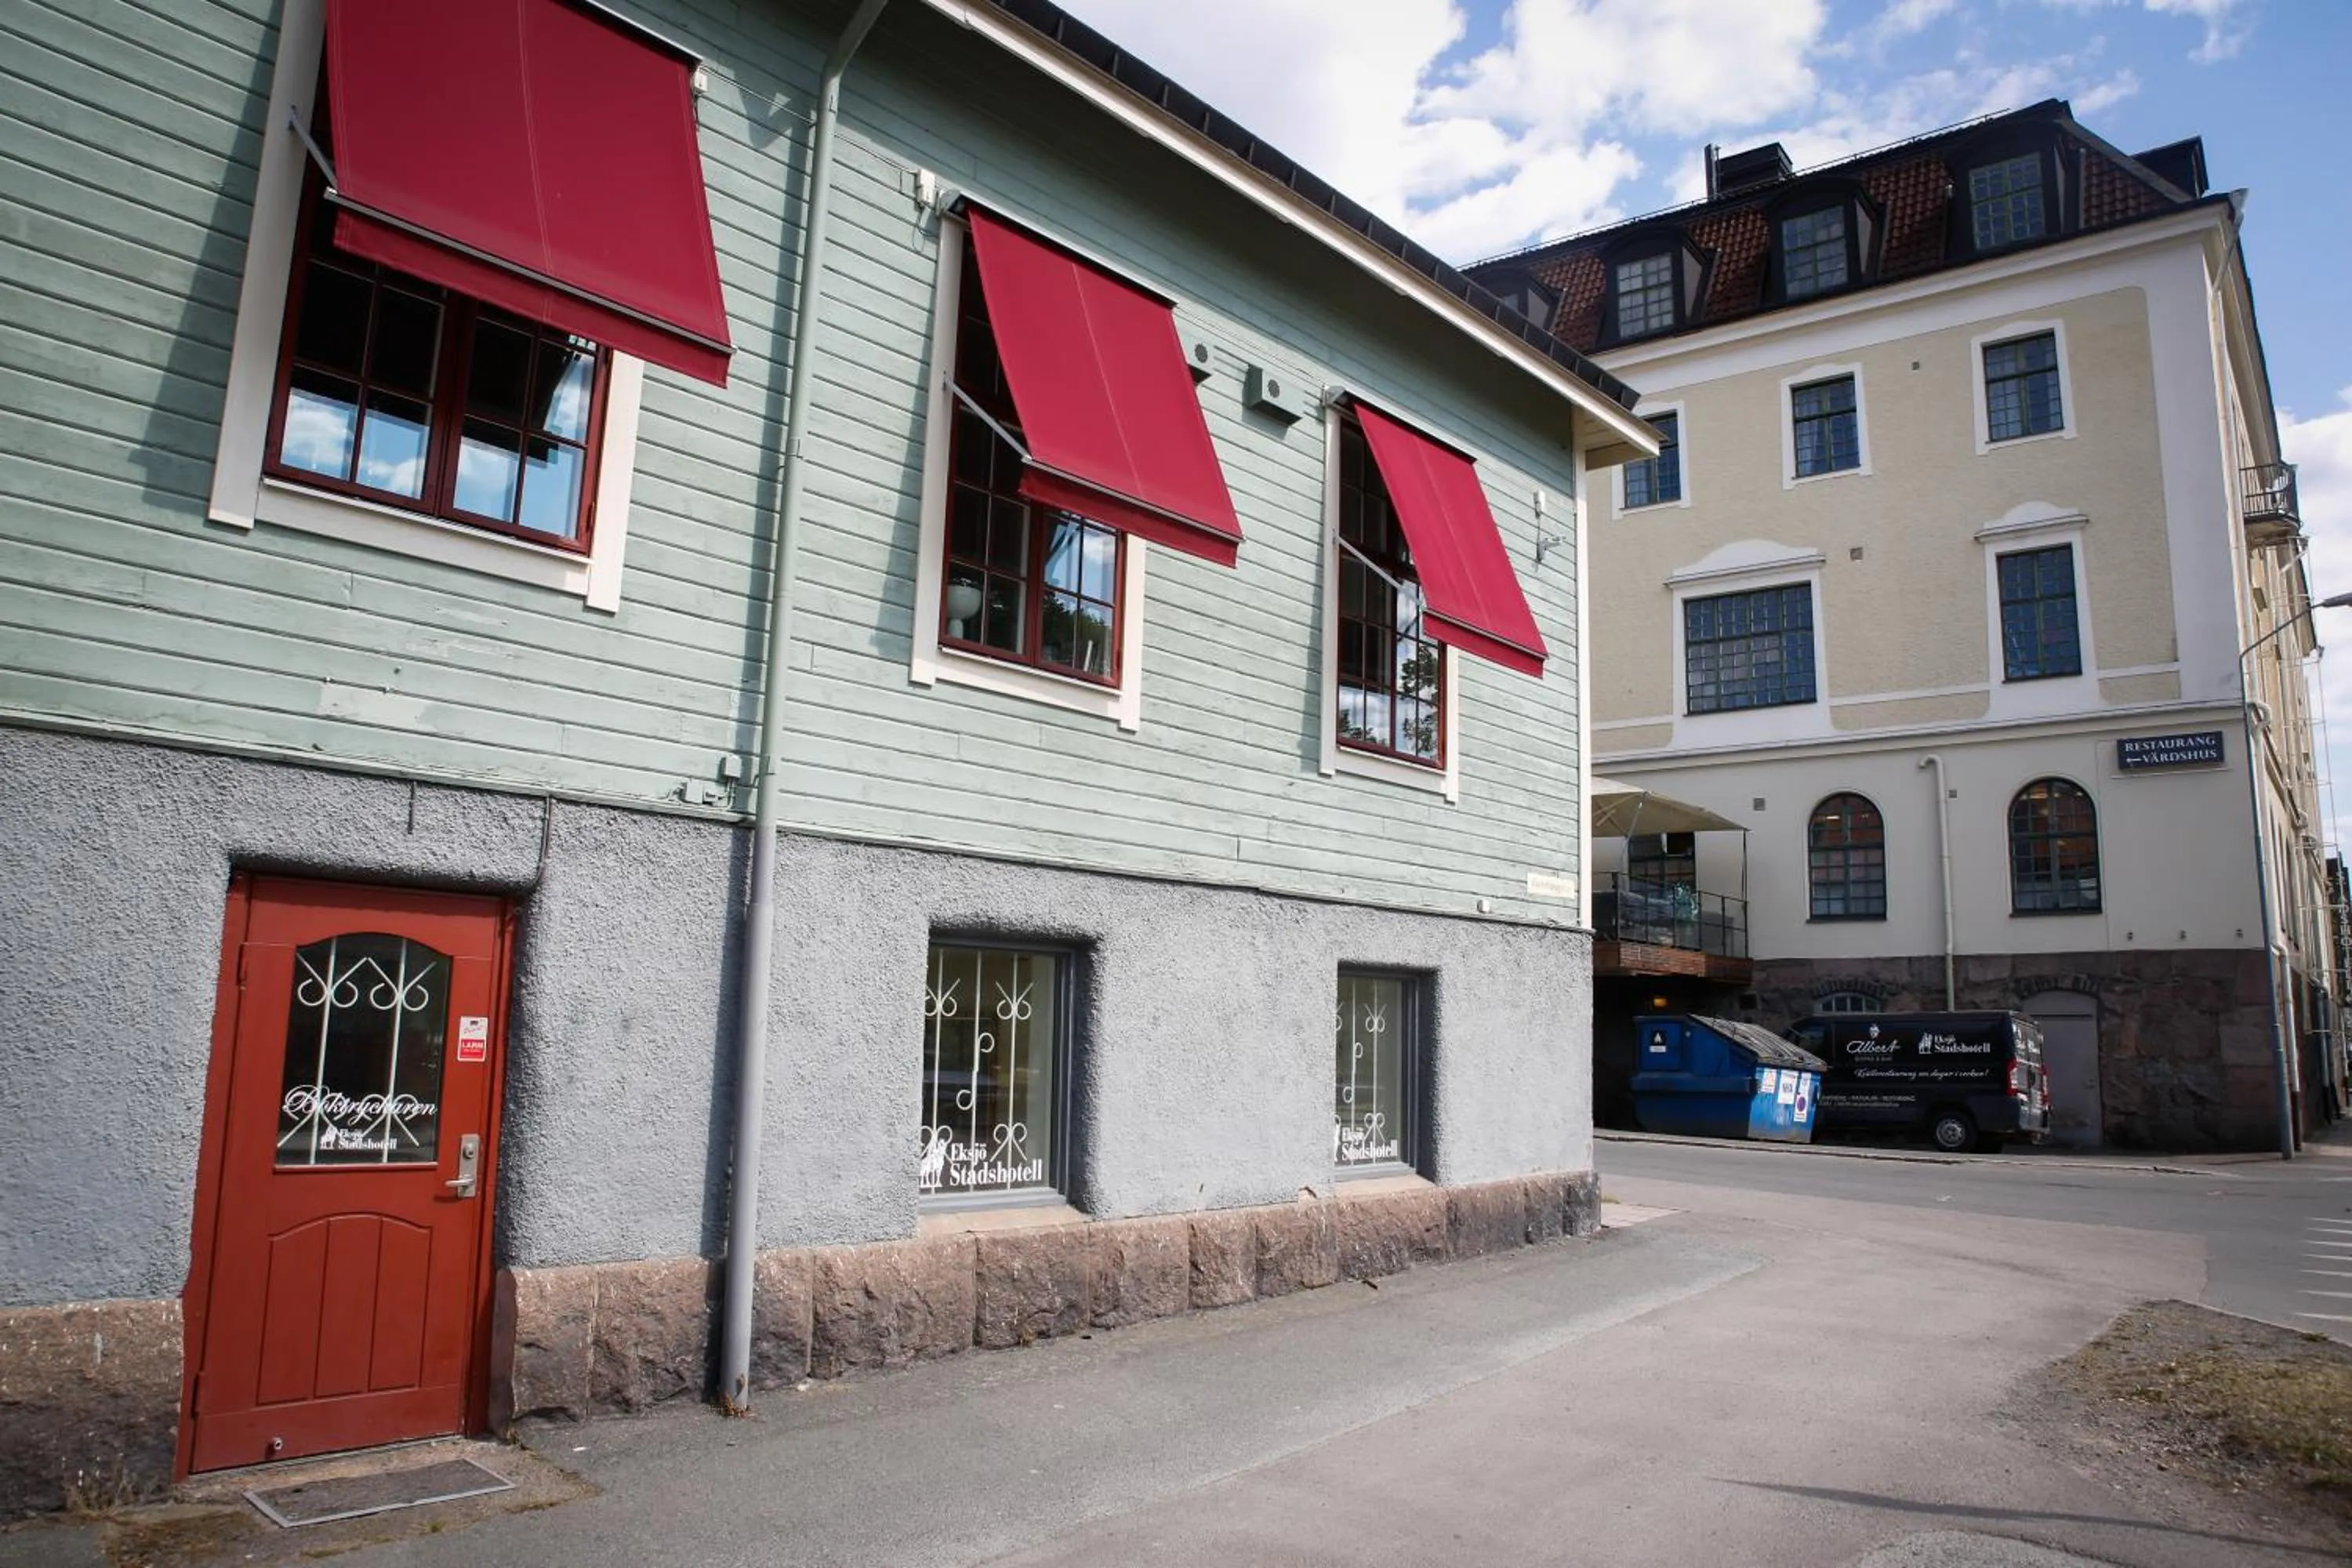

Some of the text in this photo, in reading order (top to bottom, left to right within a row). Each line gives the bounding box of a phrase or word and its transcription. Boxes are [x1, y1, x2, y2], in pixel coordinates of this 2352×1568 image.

[2125, 736, 2216, 752] RESTAURANG
[2141, 749, 2217, 763] VÄRDSHUS
[1934, 1042, 1991, 1053] Stadshotell
[338, 1138, 397, 1150] Stadshotell
[1342, 1139, 1398, 1160] Stadshotell
[951, 1142, 987, 1164] Eksjö
[949, 1159, 1043, 1186] Stadshotell
